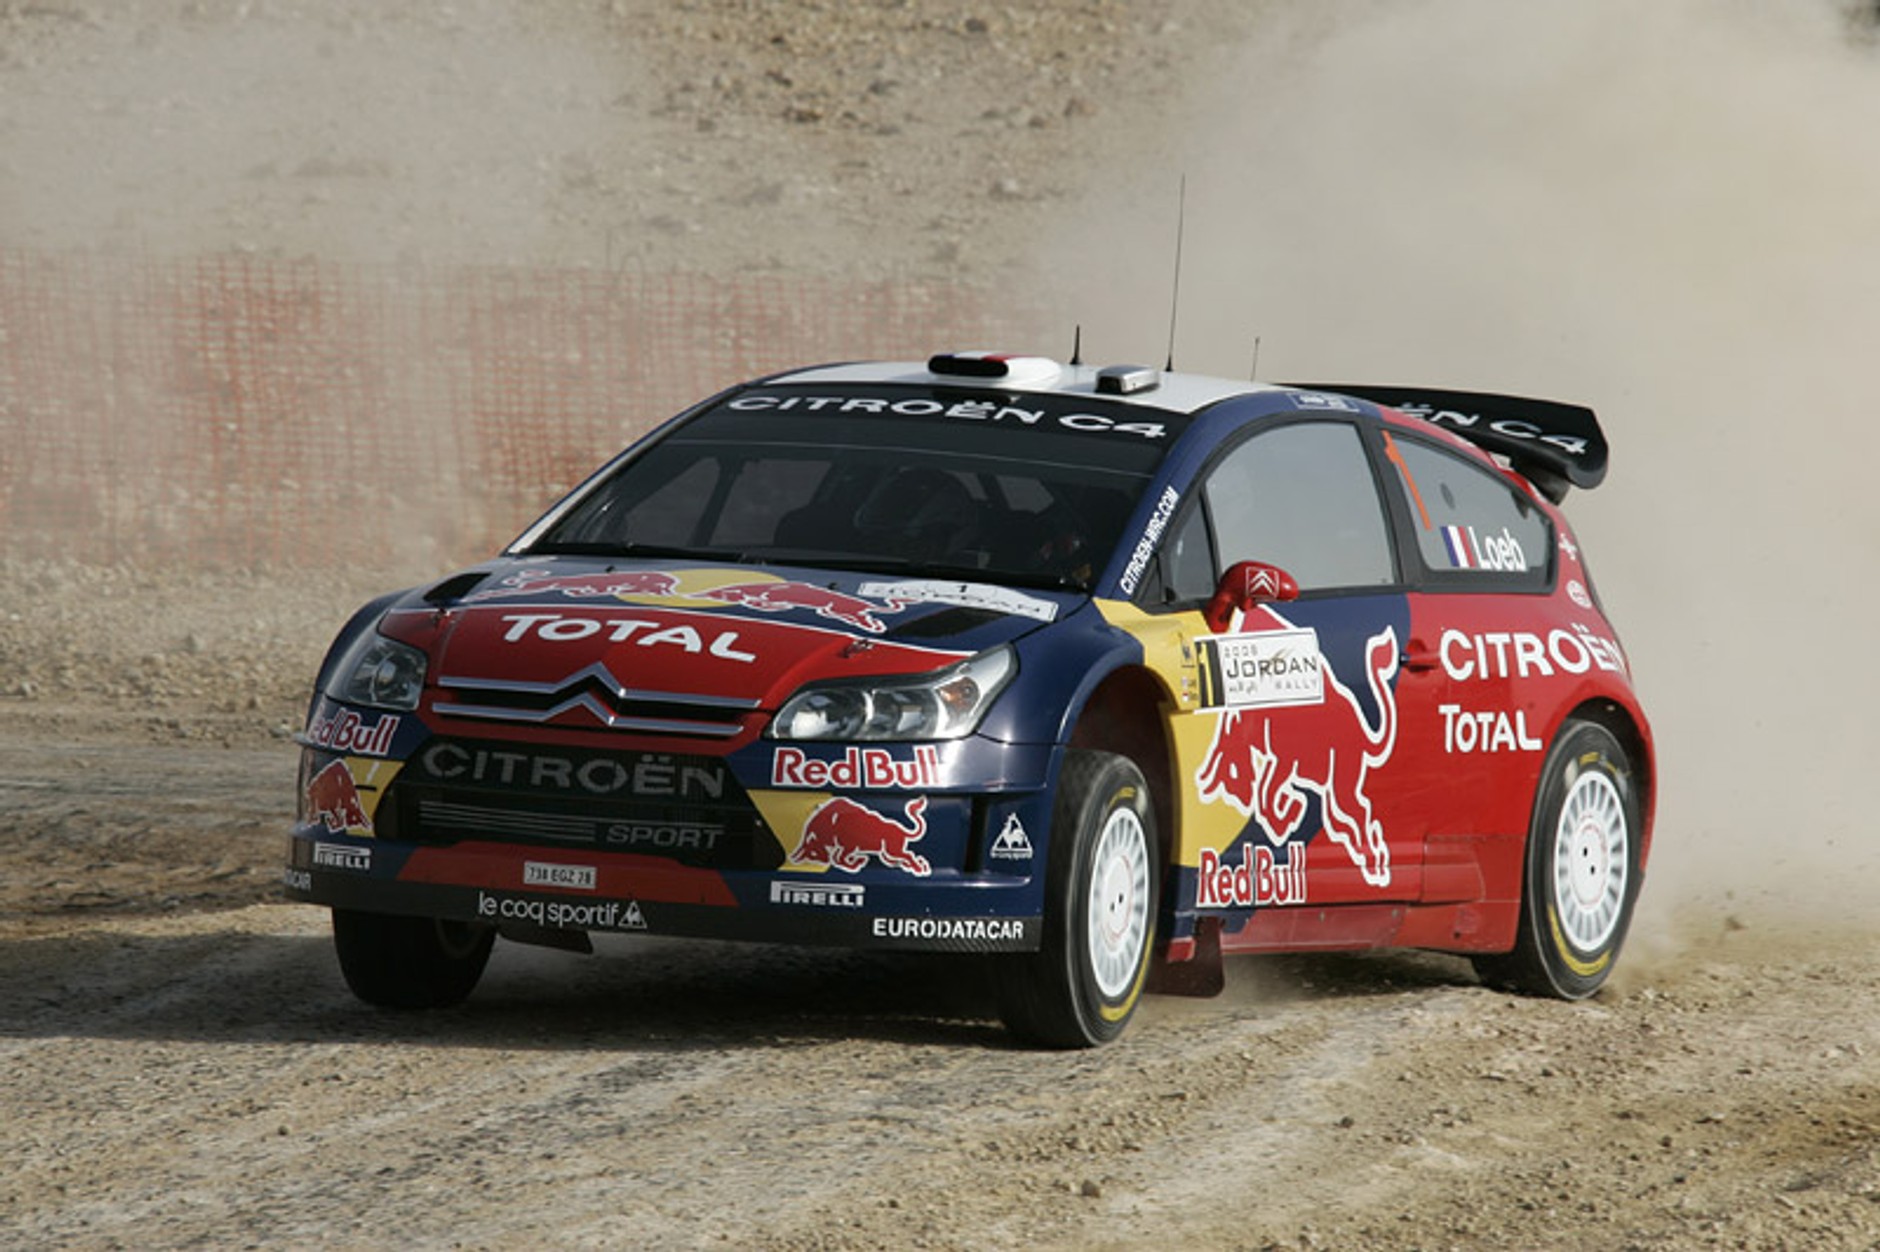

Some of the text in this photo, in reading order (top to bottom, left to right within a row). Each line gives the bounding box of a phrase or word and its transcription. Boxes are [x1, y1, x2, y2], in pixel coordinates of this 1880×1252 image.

[728, 395, 1167, 438] CITROËN C4
[1489, 420, 1589, 454] C4
[1469, 526, 1527, 571] Loeb
[501, 613, 757, 662] TOTAL
[1226, 655, 1318, 679] JORDAN
[332, 711, 400, 756] Bull
[1438, 704, 1543, 753] TOTAL
[422, 743, 725, 799] CITROËN
[772, 746, 942, 788] Red Bull
[313, 841, 372, 870] PIRELLI
[605, 824, 726, 849] SPORT
[770, 880, 866, 906] PIRELLI
[1196, 841, 1306, 908] Red Bull
[478, 891, 620, 928] le coq sportif
[872, 917, 1024, 940] EURODATACAR
